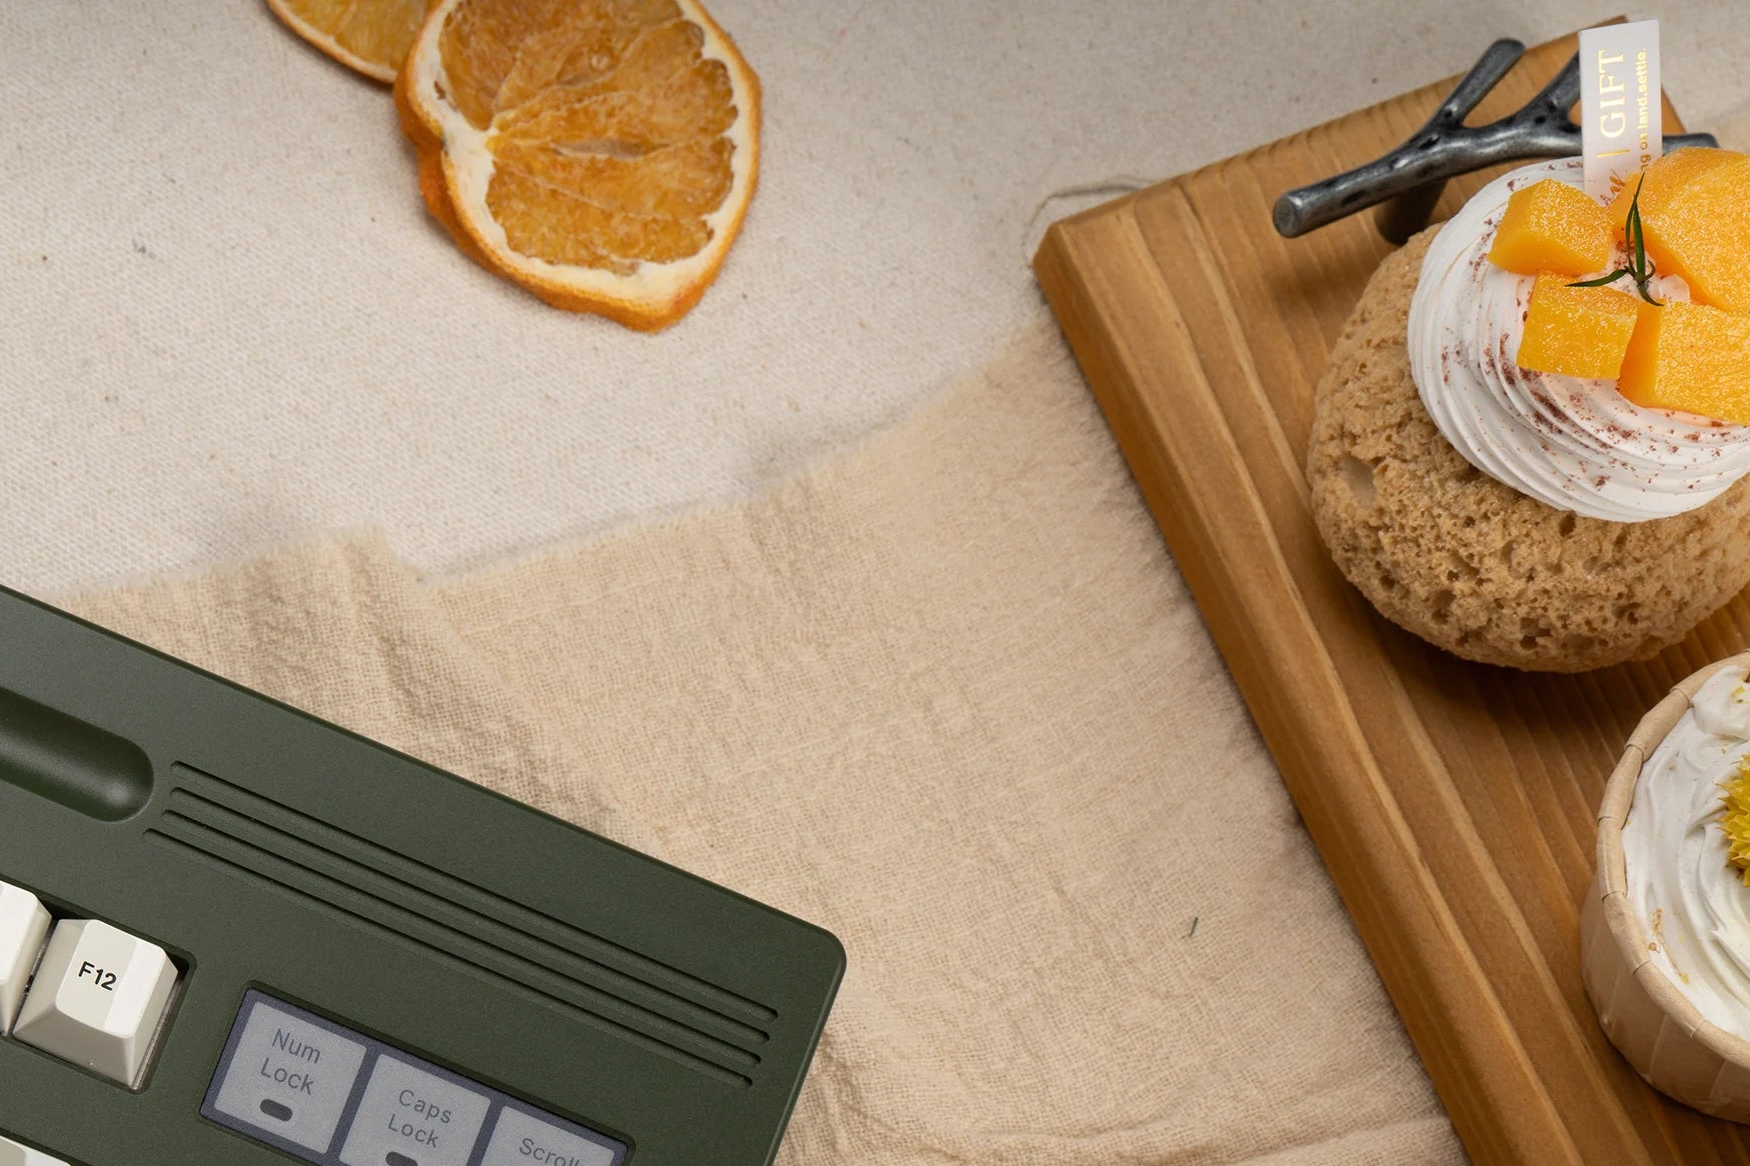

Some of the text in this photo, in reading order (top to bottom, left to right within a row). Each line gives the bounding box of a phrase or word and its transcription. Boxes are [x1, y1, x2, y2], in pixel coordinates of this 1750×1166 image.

[1597, 49, 1626, 139] GIFT
[1639, 132, 1649, 150] on
[79, 961, 116, 991] F12
[272, 1028, 320, 1064] Num
[261, 1057, 314, 1095] Lock
[399, 1090, 451, 1125] Caps
[388, 1114, 440, 1148] Lock
